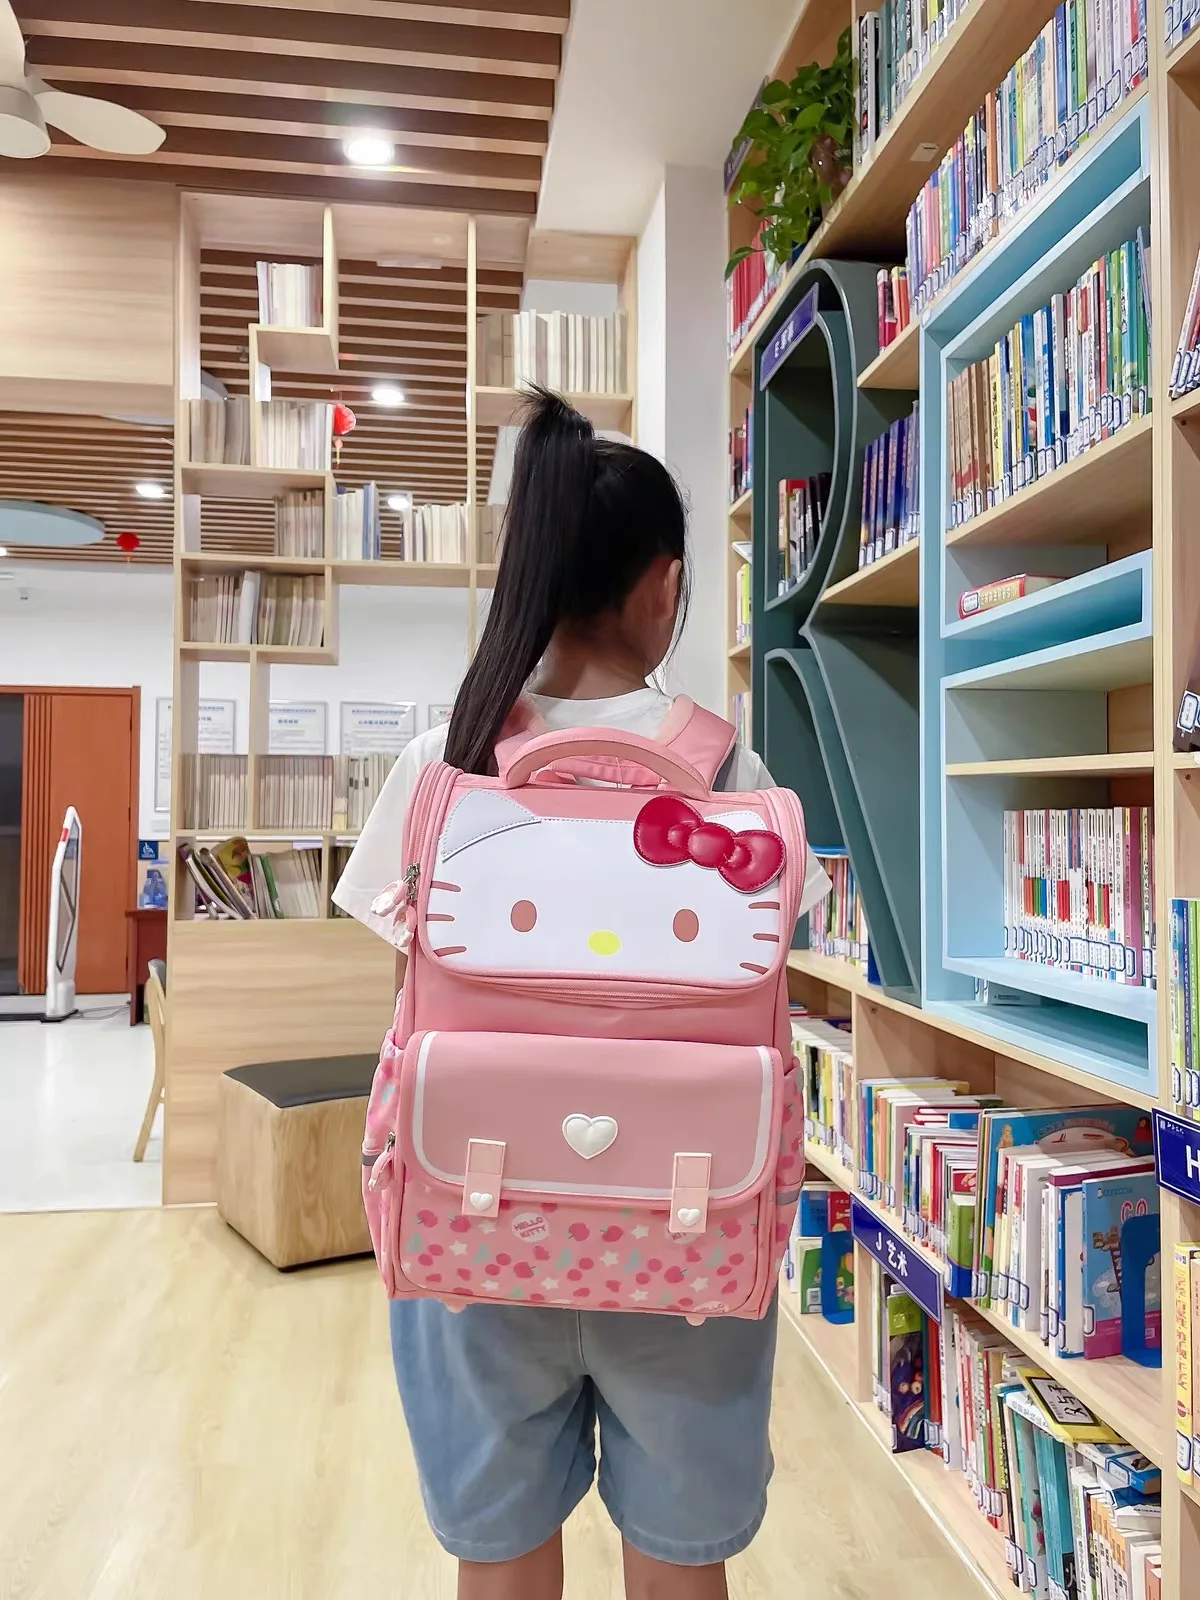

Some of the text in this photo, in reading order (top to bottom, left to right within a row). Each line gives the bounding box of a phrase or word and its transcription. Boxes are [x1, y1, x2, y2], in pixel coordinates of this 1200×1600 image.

[1185, 1144, 1200, 1182] H
[513, 1216, 544, 1231] HELLO
[519, 1225, 546, 1238] KITTY
